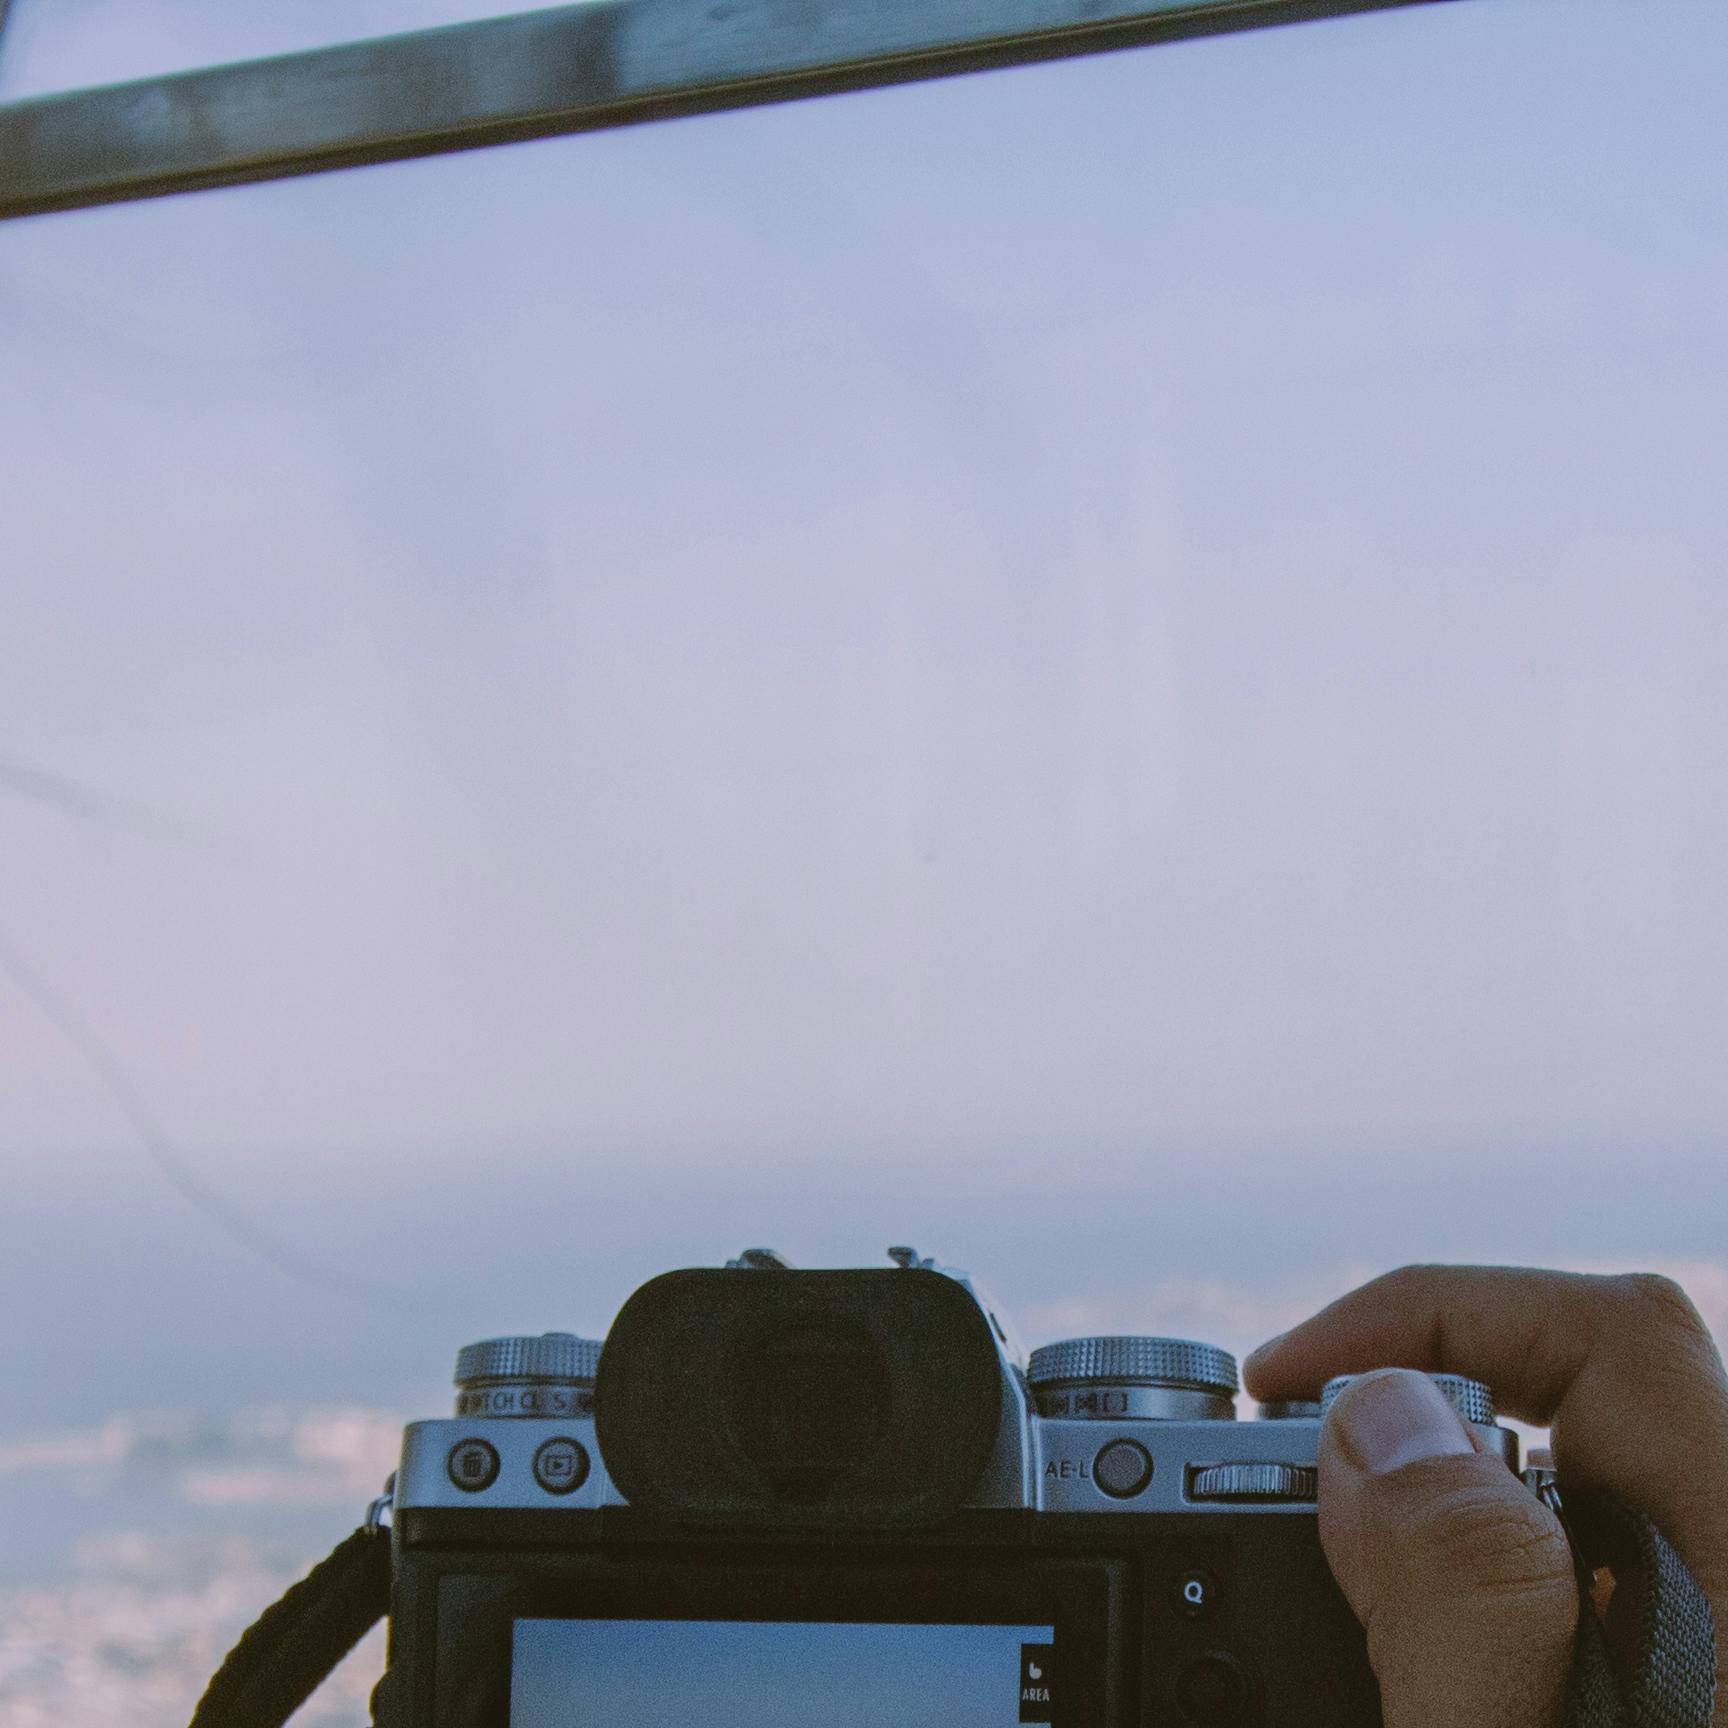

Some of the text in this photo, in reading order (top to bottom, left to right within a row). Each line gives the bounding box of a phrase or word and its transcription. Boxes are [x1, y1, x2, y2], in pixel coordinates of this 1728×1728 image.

[1045, 1460, 1089, 1479] AE-L
[1183, 1580, 1203, 1604] Q
[1022, 1687, 1050, 1702] AREA
